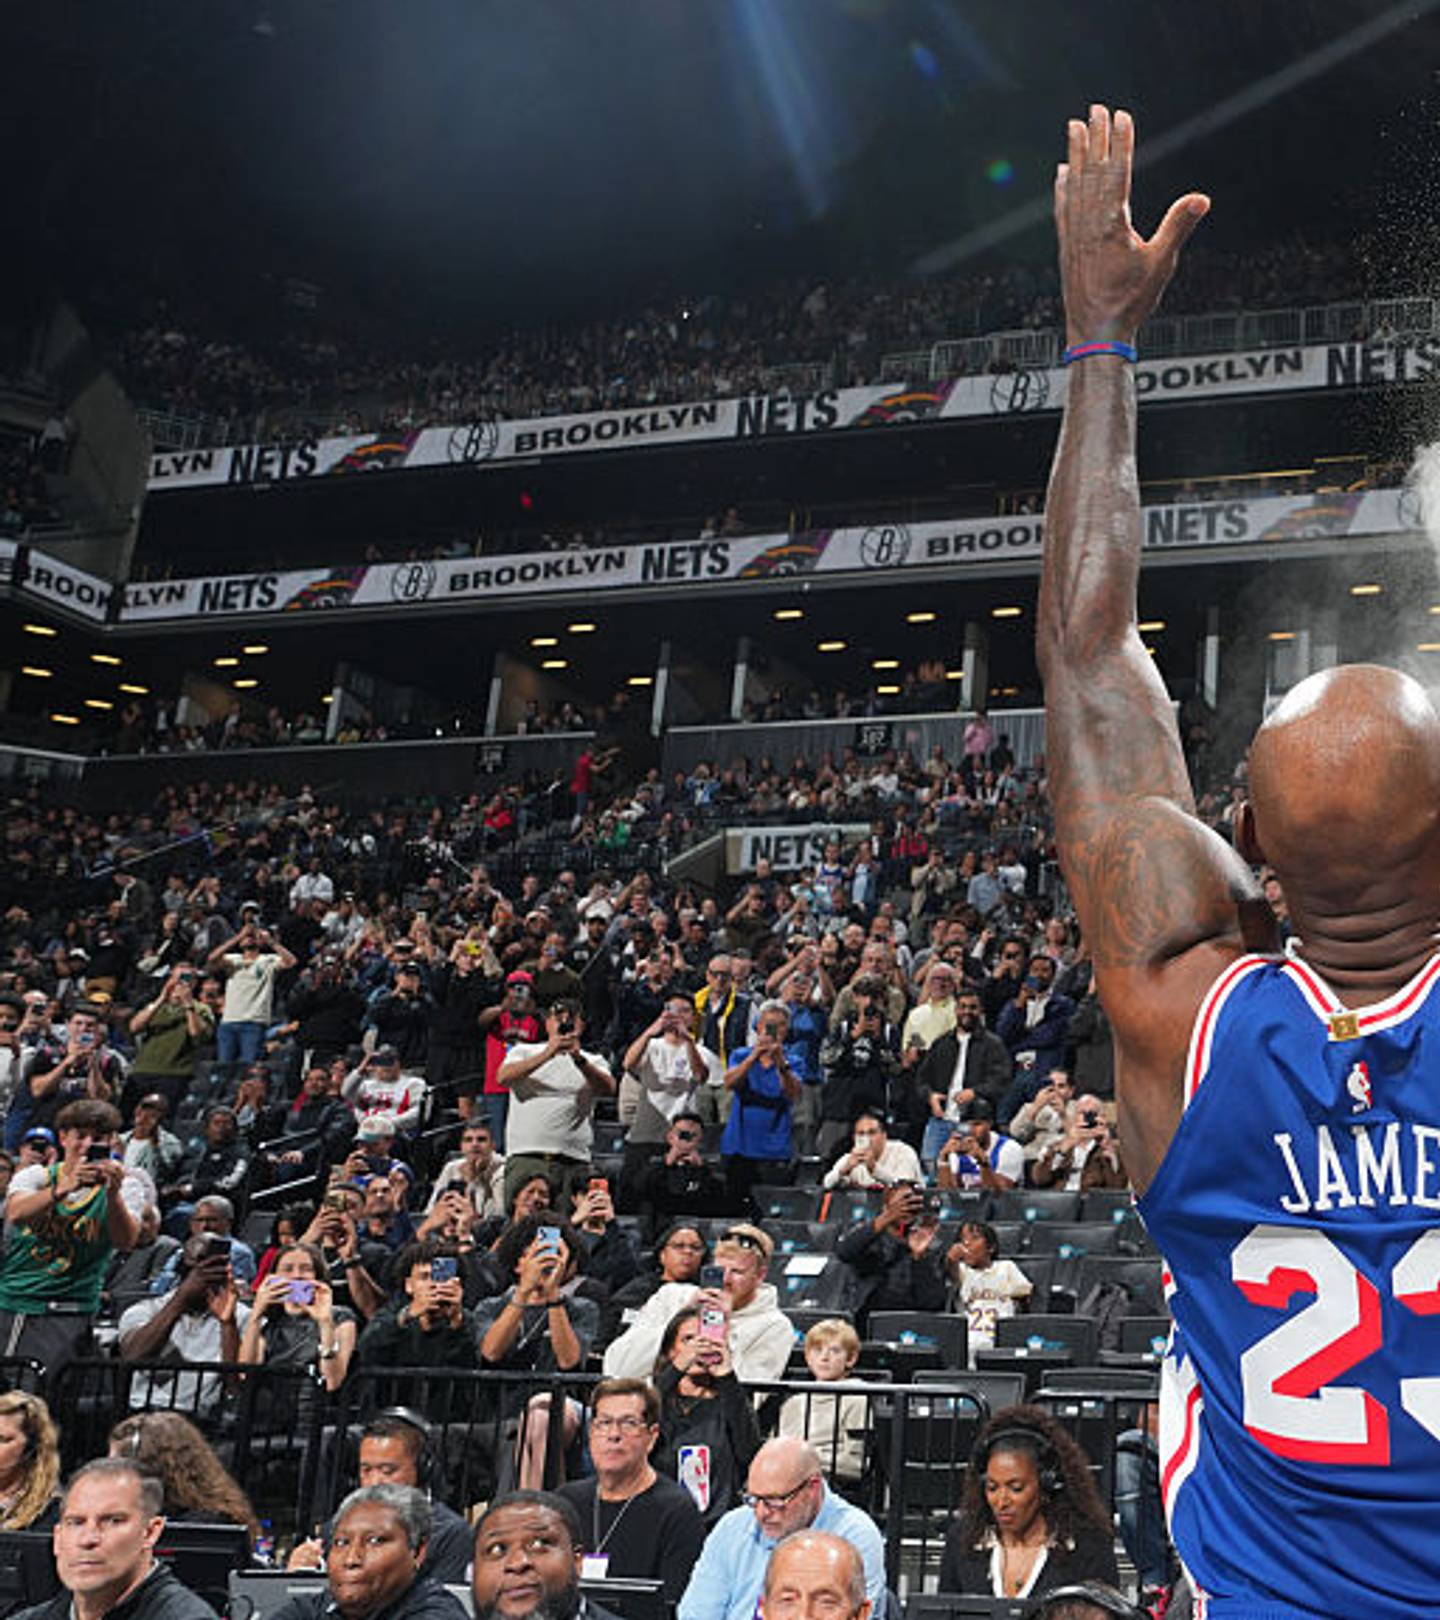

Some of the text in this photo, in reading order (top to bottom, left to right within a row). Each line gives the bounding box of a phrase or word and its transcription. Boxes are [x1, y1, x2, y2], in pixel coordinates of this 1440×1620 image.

[228, 439, 319, 484] NETS
[514, 403, 717, 454] BROOKLYN
[736, 388, 840, 438] NETS
[1136, 350, 1303, 393] OOKLYN
[199, 577, 279, 612] NETS
[447, 551, 625, 593] BROOKLYN
[641, 542, 731, 581] NETS
[1148, 503, 1249, 545] NETS
[750, 833, 832, 866] NETS
